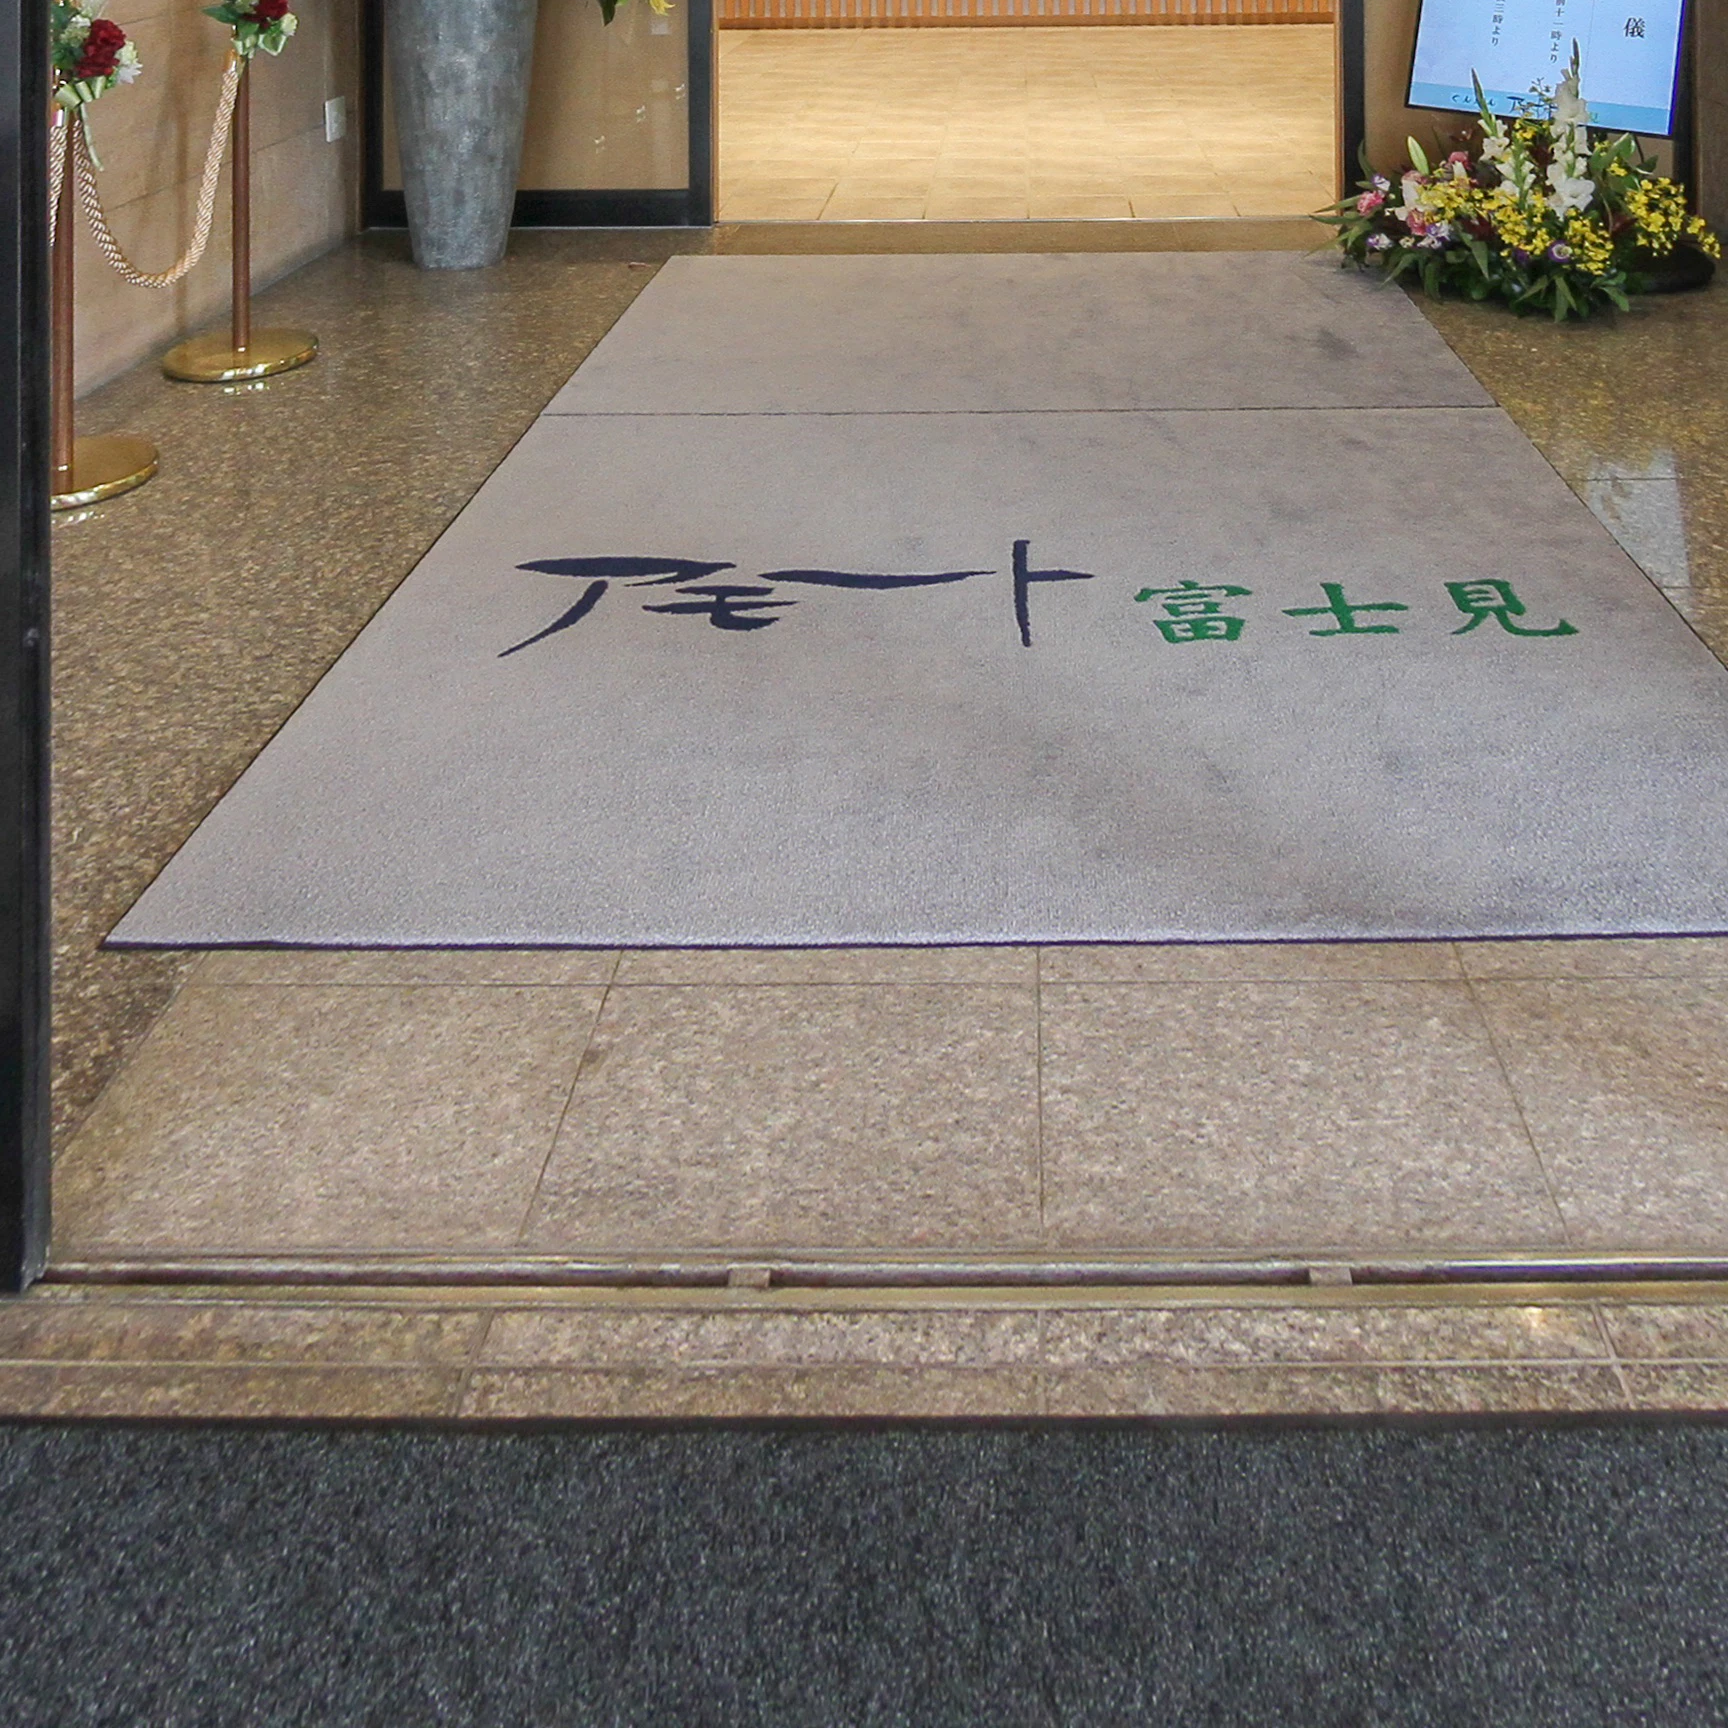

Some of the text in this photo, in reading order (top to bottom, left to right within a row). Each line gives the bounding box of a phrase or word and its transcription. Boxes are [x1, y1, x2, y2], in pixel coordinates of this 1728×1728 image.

[1623, 17, 1646, 39] 儀
[497, 539, 1580, 658] アモート 富士見
